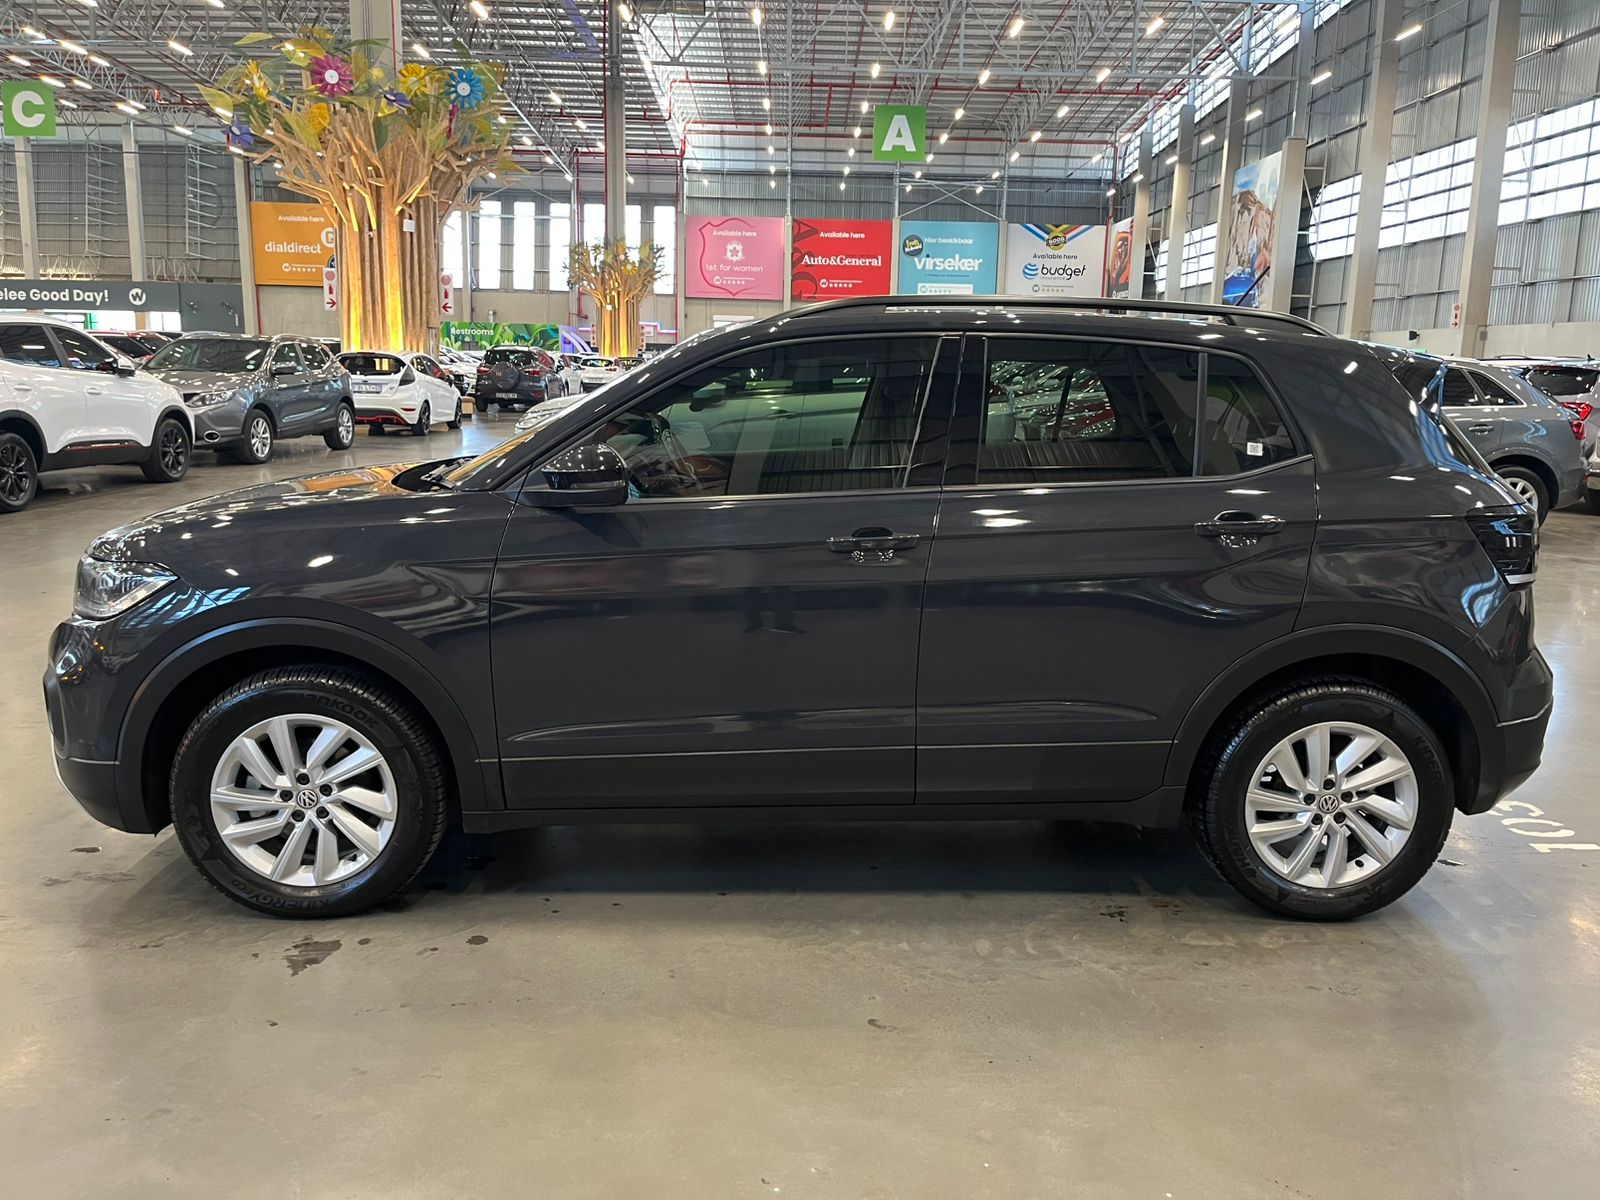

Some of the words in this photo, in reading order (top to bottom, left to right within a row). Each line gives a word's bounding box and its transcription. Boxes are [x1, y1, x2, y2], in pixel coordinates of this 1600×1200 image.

[12, 90, 45, 128] C
[881, 114, 917, 152] A
[278, 214, 308, 222] Available
[712, 229, 742, 237] Available
[264, 241, 322, 254] dialdirect
[801, 254, 882, 267] Auto&General
[914, 253, 983, 271] virseker
[705, 263, 717, 271] 1st
[720, 264, 731, 272] for
[1040, 264, 1087, 280] budget
[29, 288, 70, 302] Good
[73, 289, 110, 306] Day!
[451, 327, 494, 336] Restrooms
